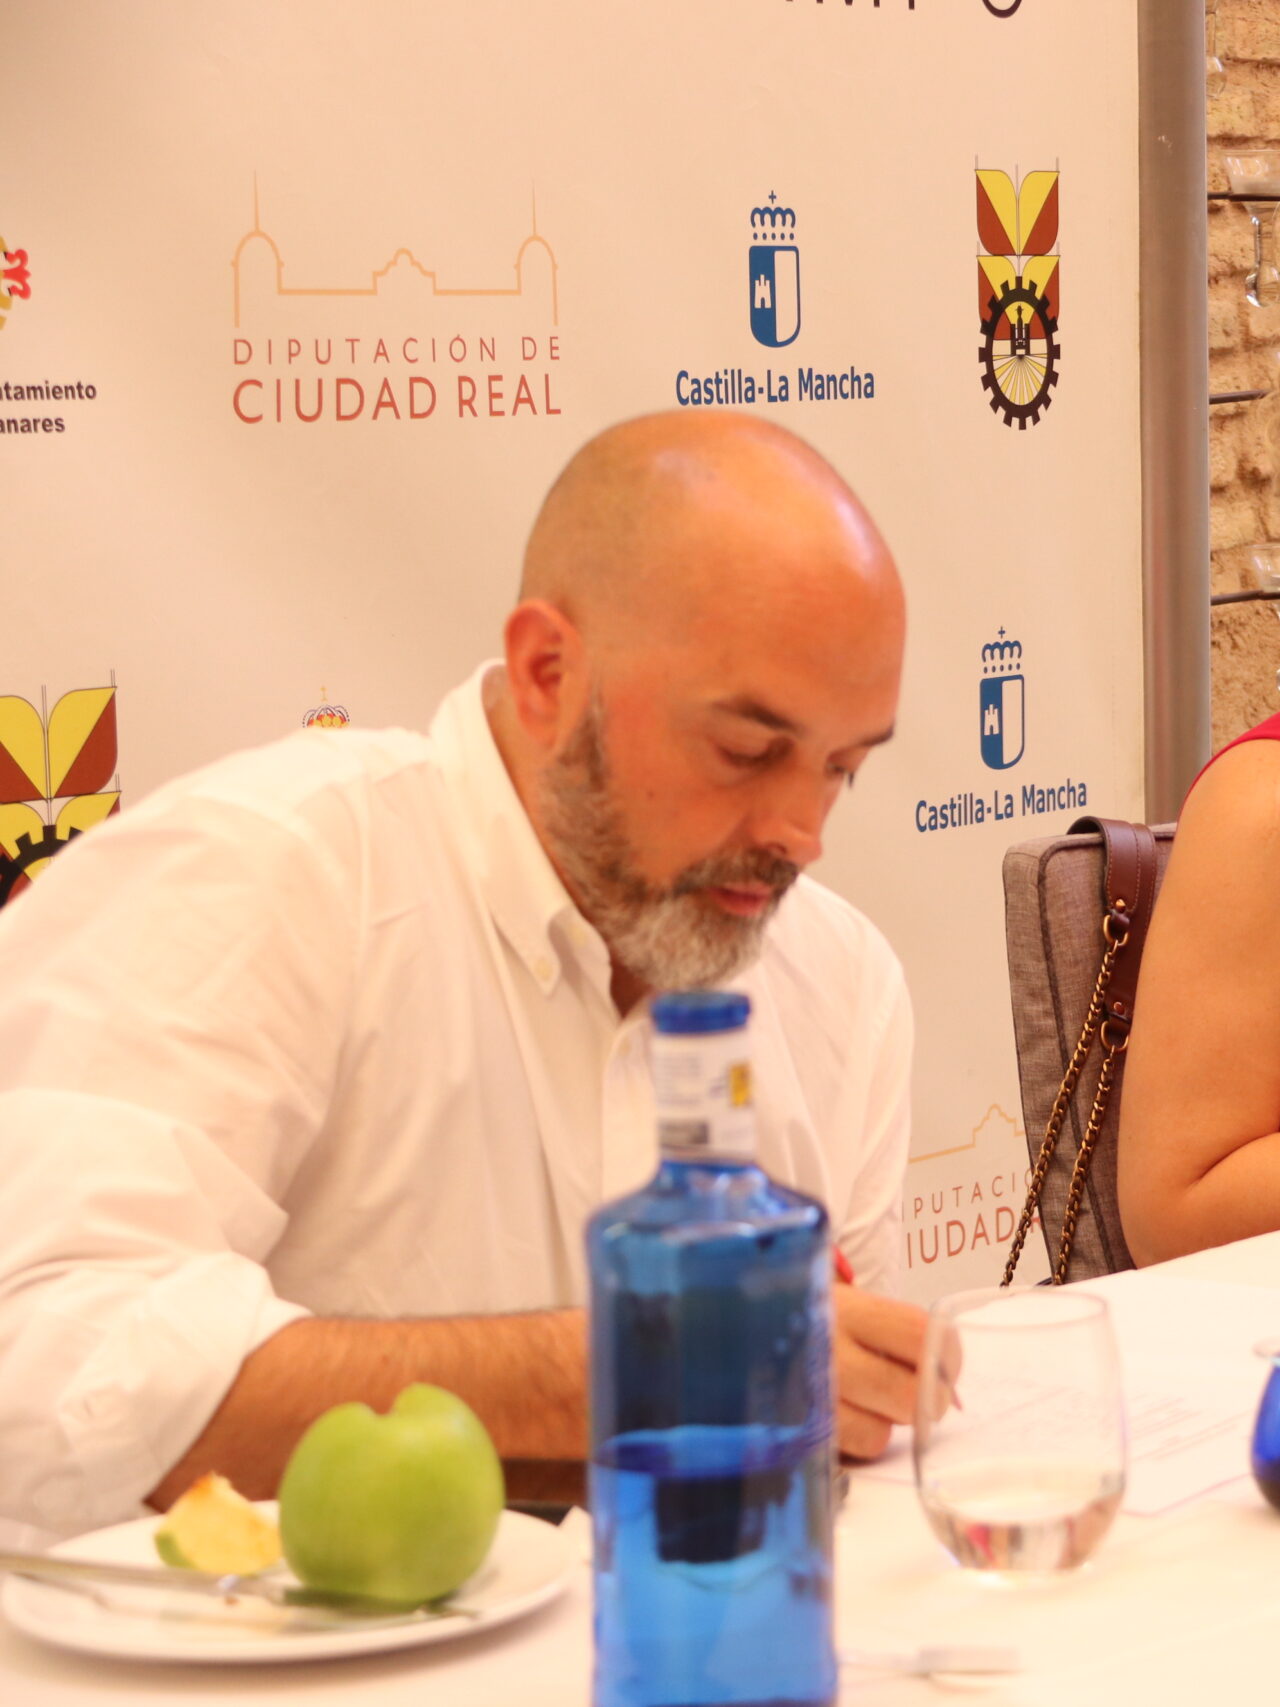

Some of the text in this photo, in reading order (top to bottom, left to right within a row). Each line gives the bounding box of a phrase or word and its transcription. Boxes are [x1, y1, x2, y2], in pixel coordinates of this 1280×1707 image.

[233, 334, 560, 365] DIPUTACIÓN DE
[0, 380, 97, 401] tamiento
[233, 373, 562, 424] CIUDAD REAL
[675, 365, 875, 406] Castilla-La Mancha
[915, 778, 1088, 833] Castilla-La Mancha
[907, 1206, 1016, 1269] IUDAD
